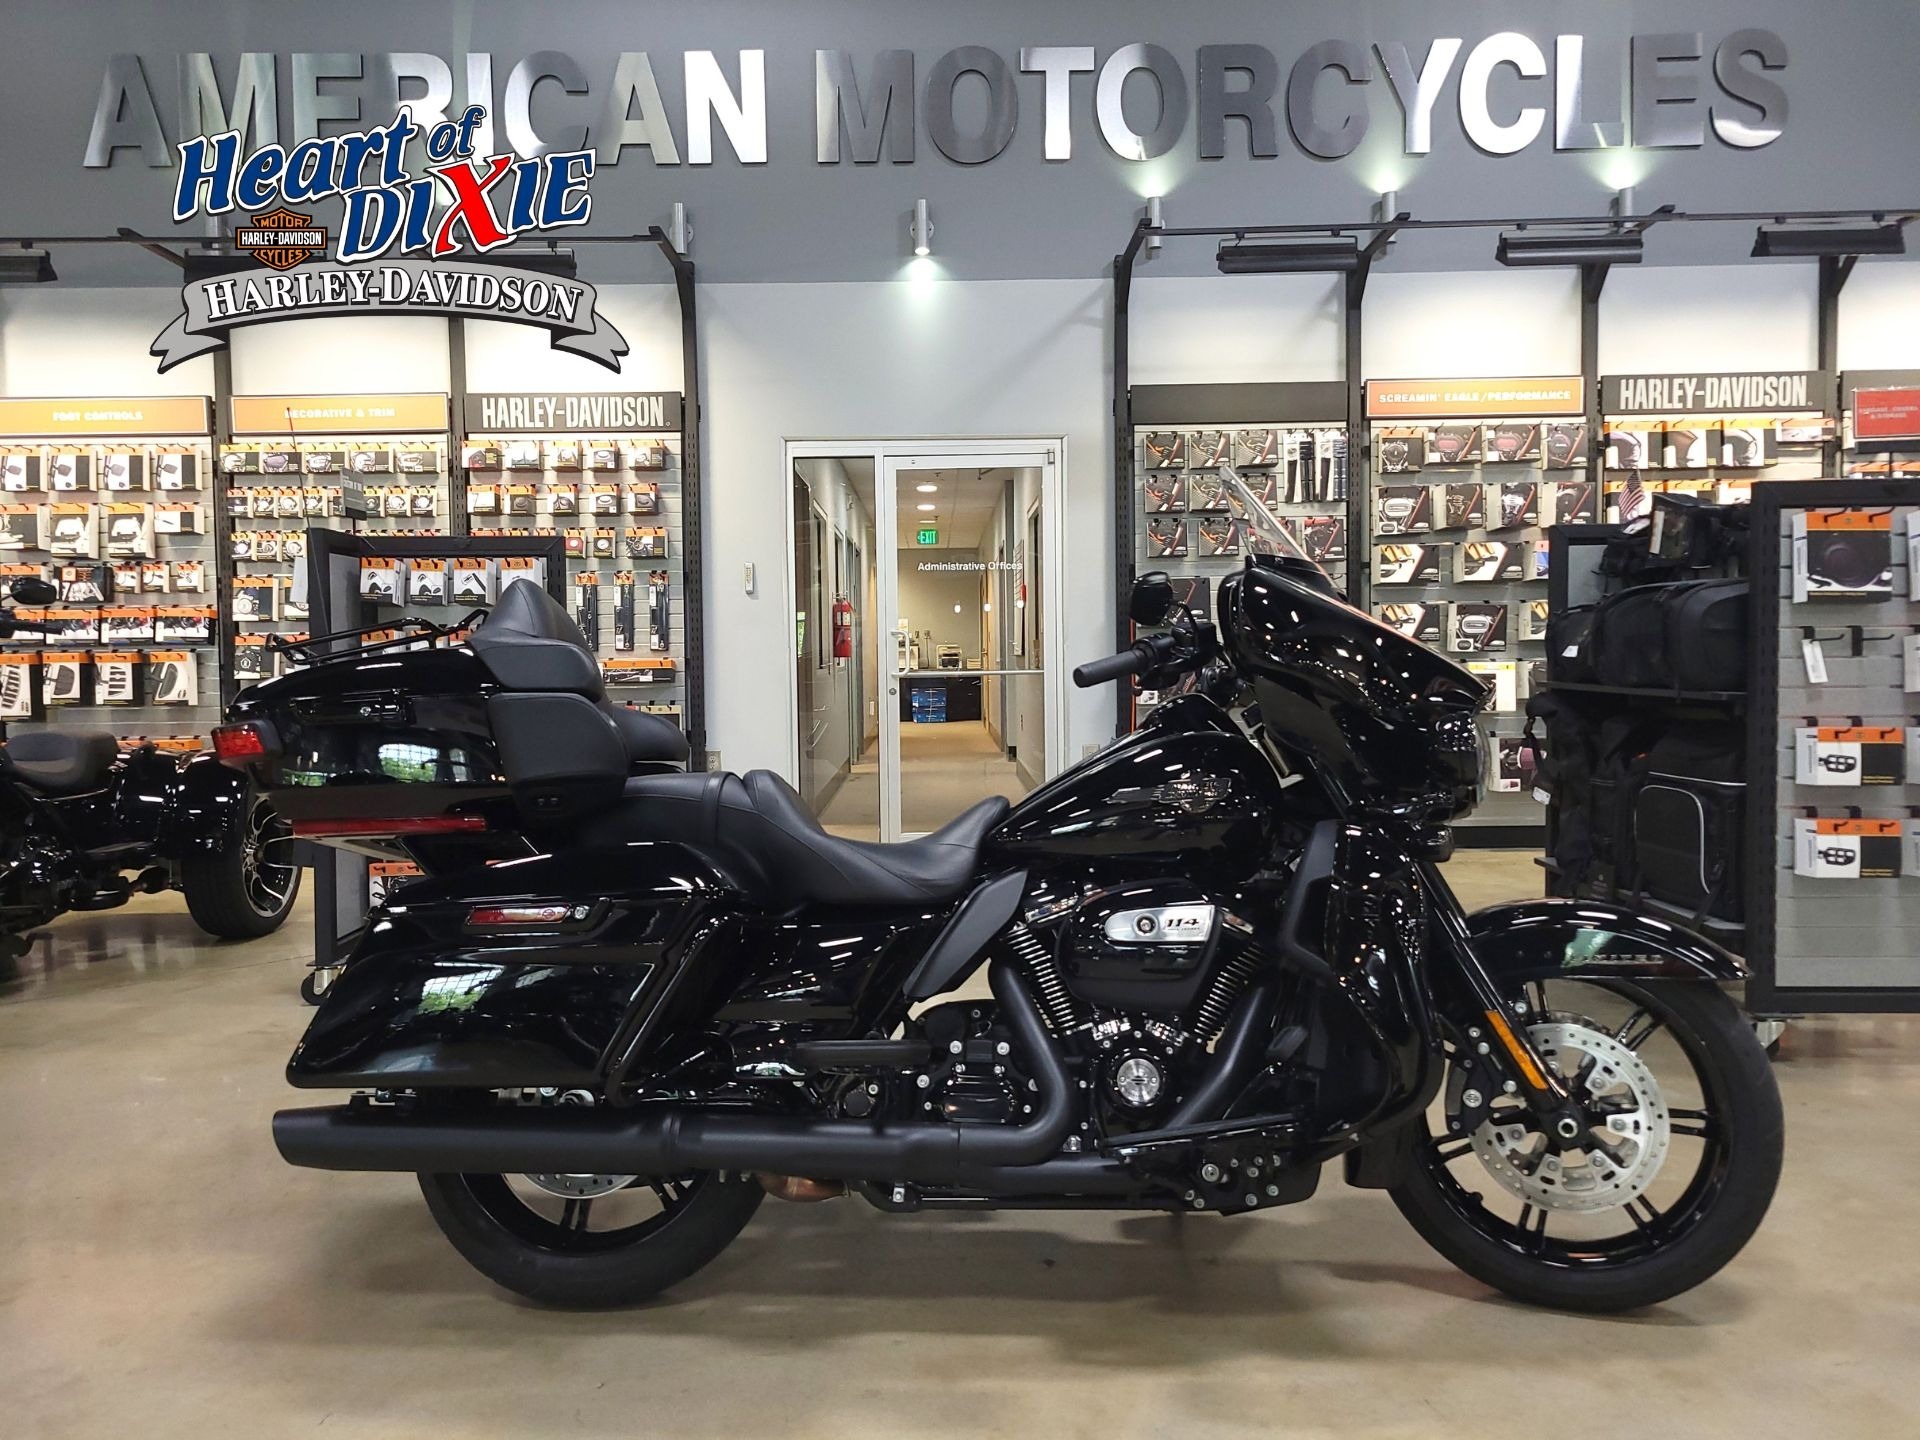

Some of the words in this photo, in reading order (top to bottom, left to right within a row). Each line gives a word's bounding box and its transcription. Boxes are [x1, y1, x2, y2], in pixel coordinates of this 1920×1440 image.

[83, 49, 768, 168] AMERICAN
[815, 29, 1790, 164] MOTORCYCLES
[1379, 393, 1441, 404] SCREAMIN'
[1619, 375, 1808, 410] HARLEY-DAVIDSON
[83, 410, 144, 421] CONTROLS
[284, 408, 353, 419] DECORATIVE
[368, 407, 396, 417] TRIM
[481, 396, 664, 429] HARLEY-DAVIDSON
[920, 530, 937, 544] EXIT
[917, 561, 986, 572] Administrative
[988, 560, 1023, 571] Offices
[1165, 918, 1200, 928] 114
